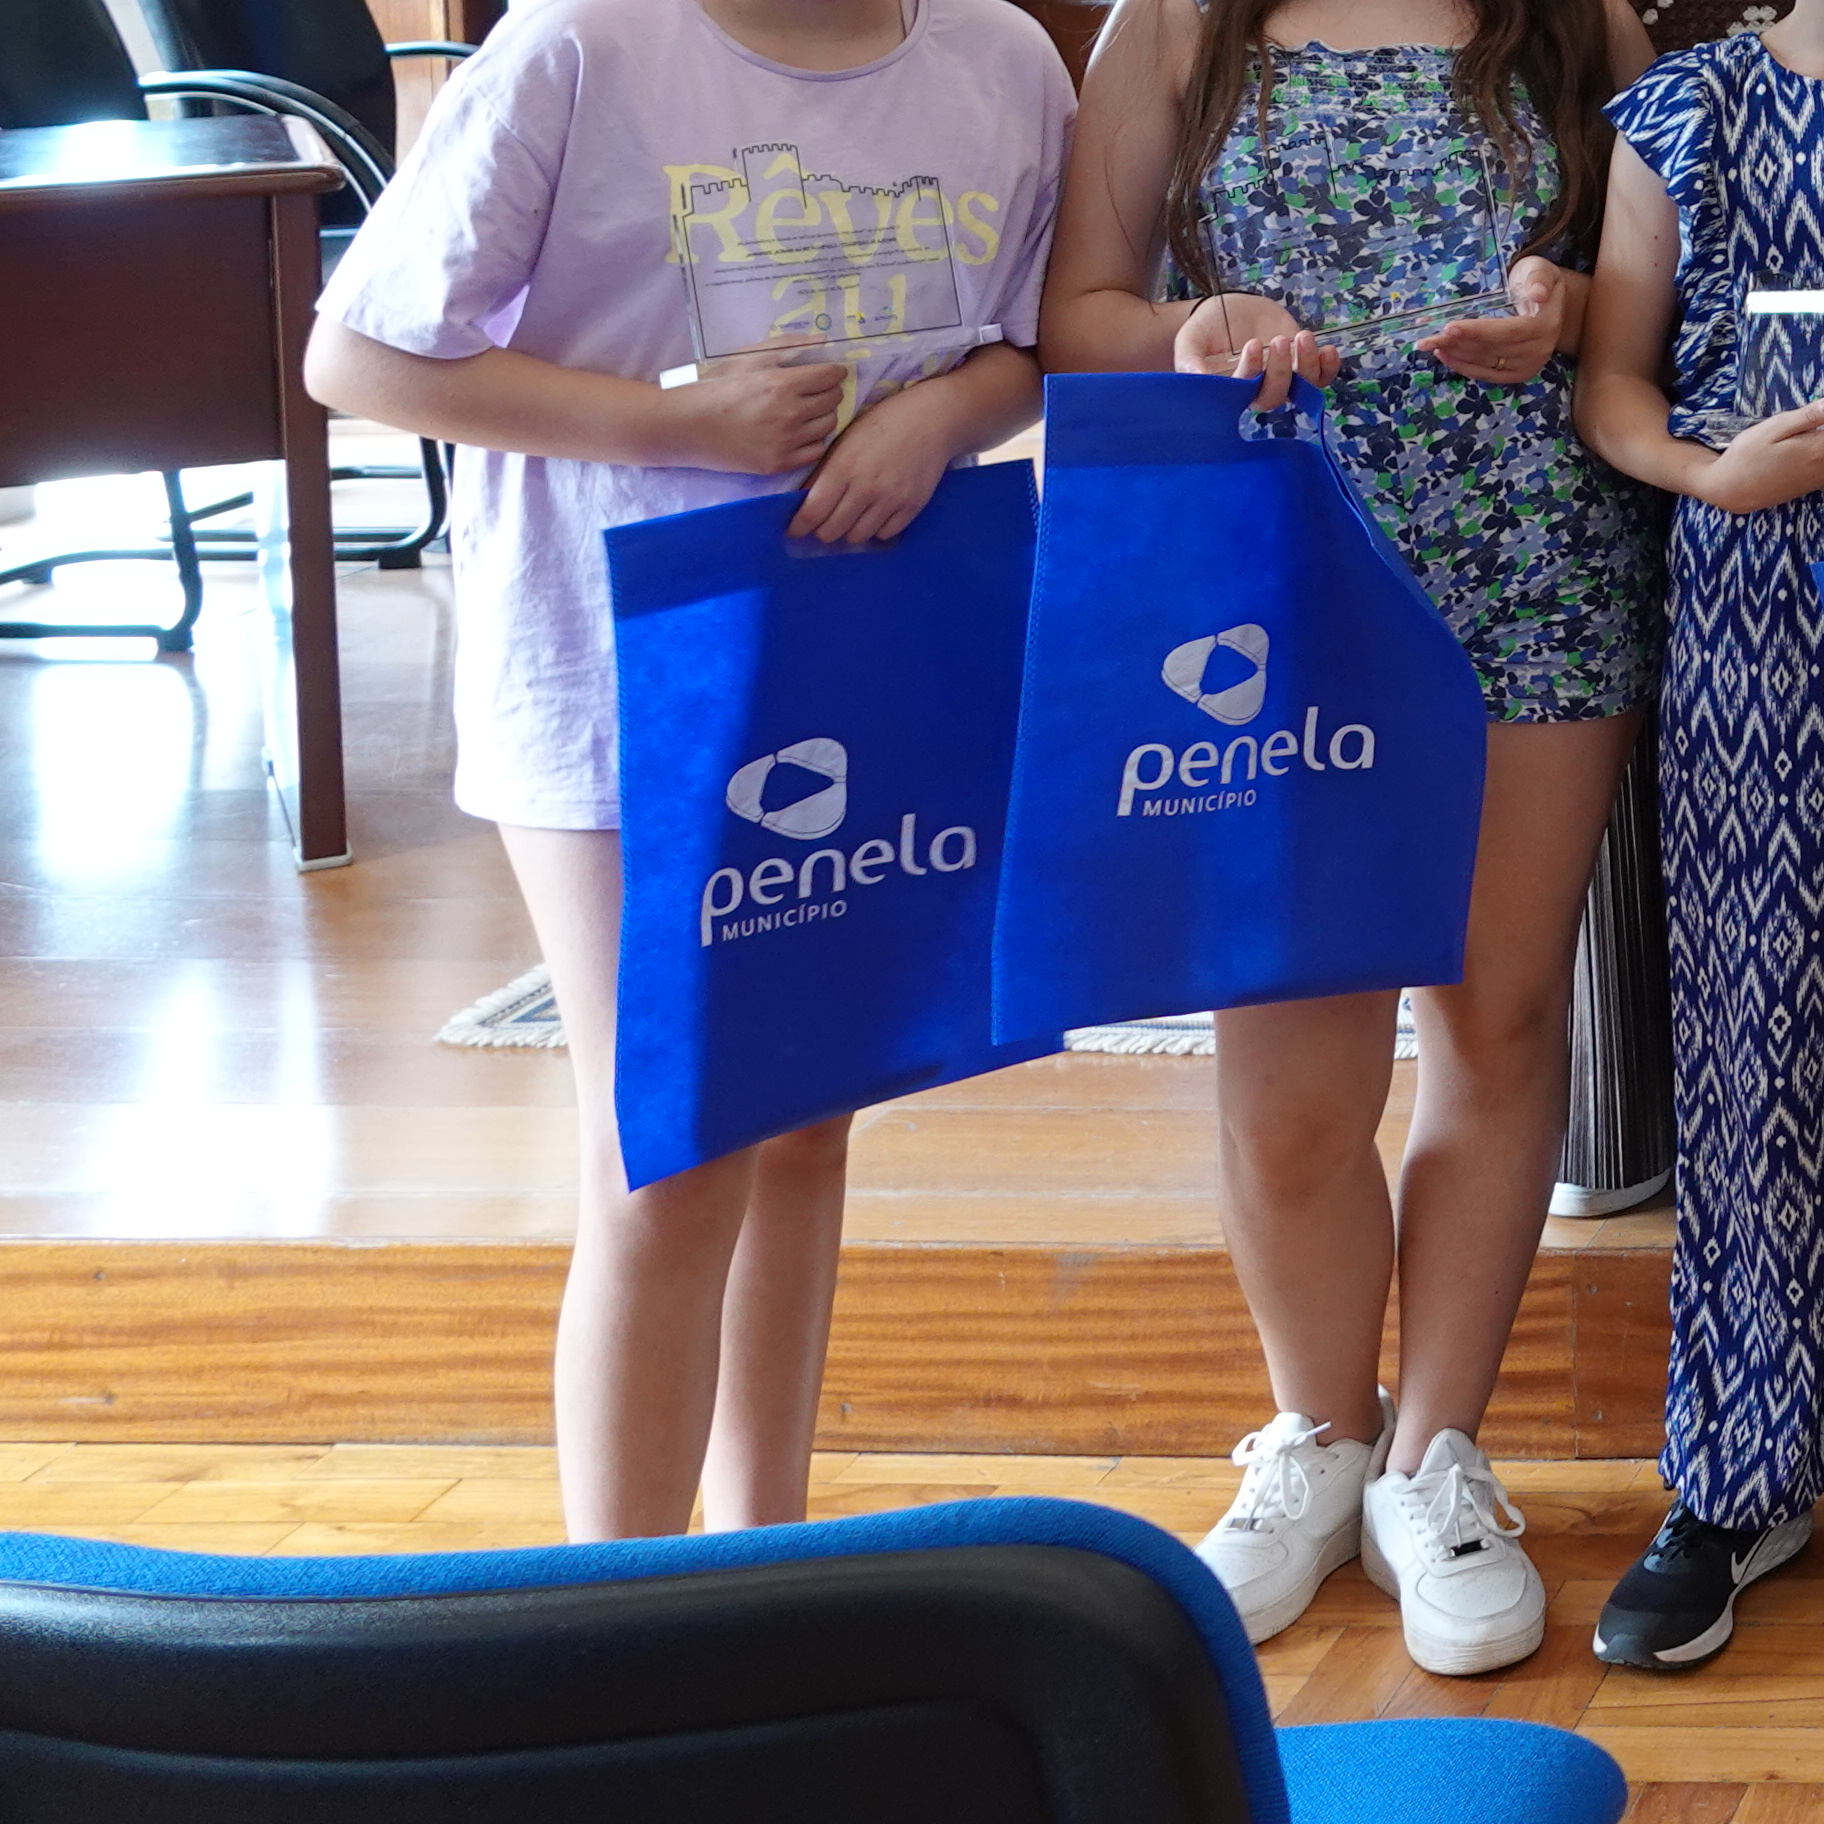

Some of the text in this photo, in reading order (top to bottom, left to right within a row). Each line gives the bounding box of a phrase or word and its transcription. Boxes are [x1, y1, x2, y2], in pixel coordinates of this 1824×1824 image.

[663, 153, 1001, 266] Rêves
[1116, 706, 1375, 817] penela
[1142, 789, 1257, 817] MUNICÍPIO
[700, 813, 977, 948] penela
[722, 899, 848, 942] MUNICÍPIO
